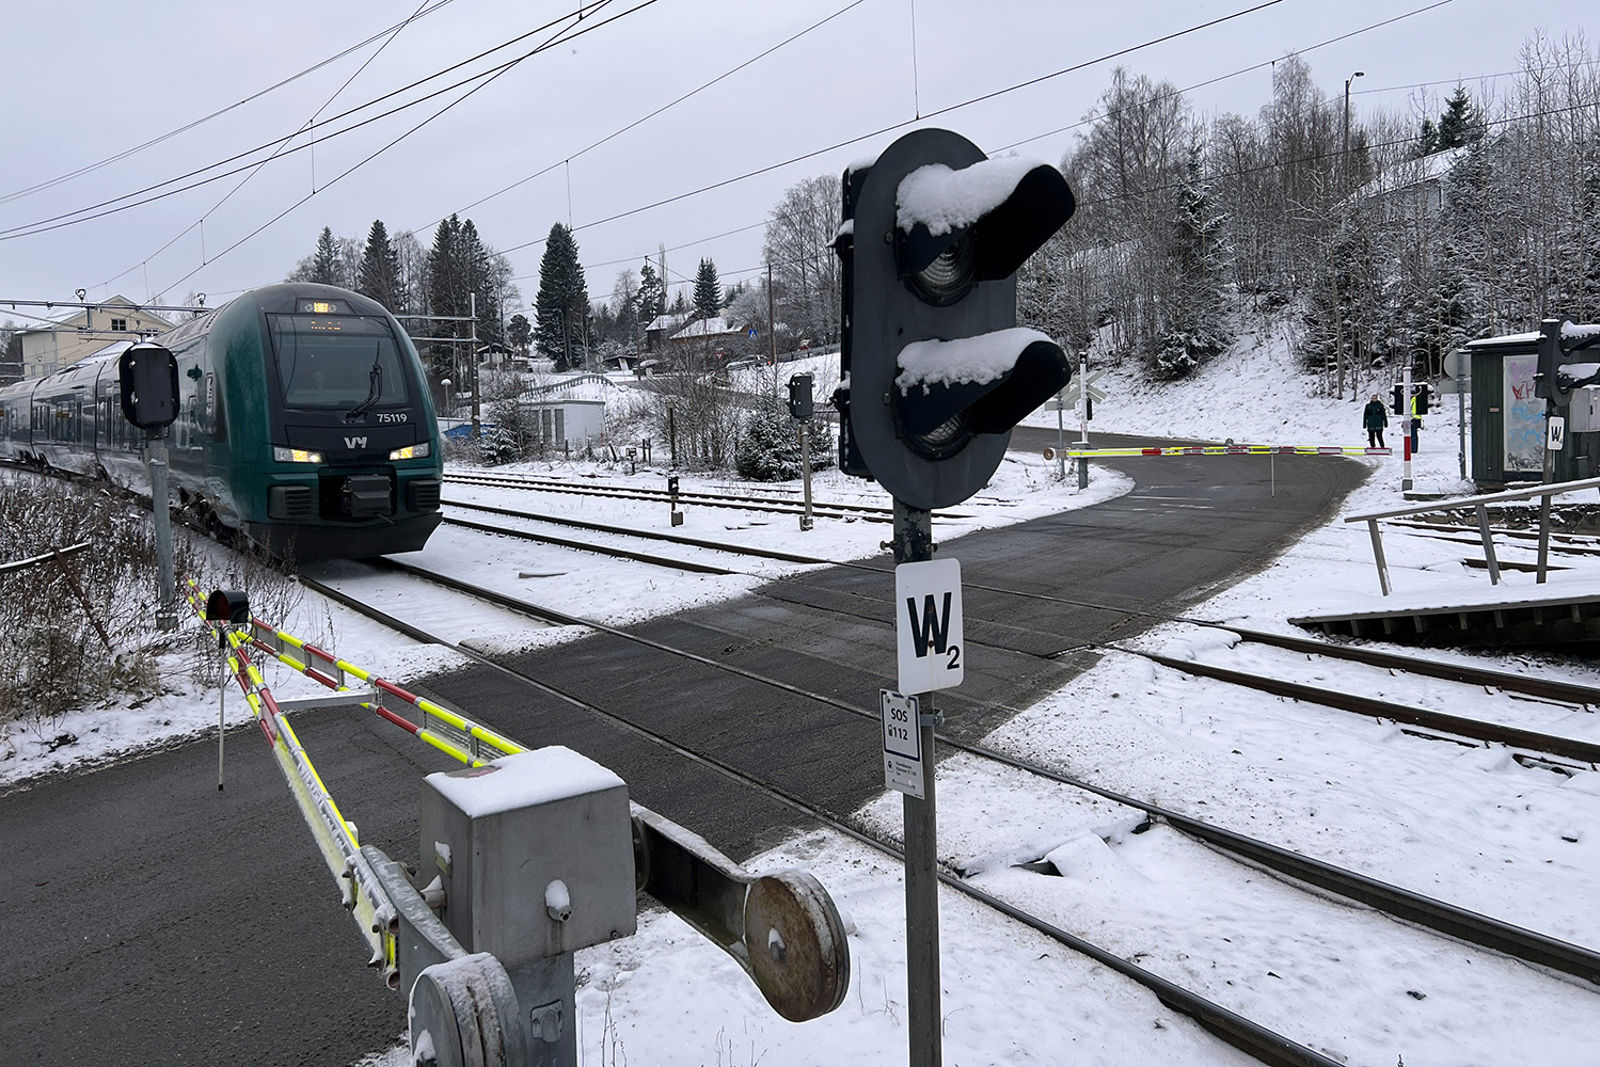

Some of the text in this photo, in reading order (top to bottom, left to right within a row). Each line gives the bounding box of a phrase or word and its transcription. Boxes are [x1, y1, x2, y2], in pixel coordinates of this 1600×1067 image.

[376, 413, 408, 423] 75119
[890, 707, 908, 722] SOS
[893, 726, 908, 740] 112
